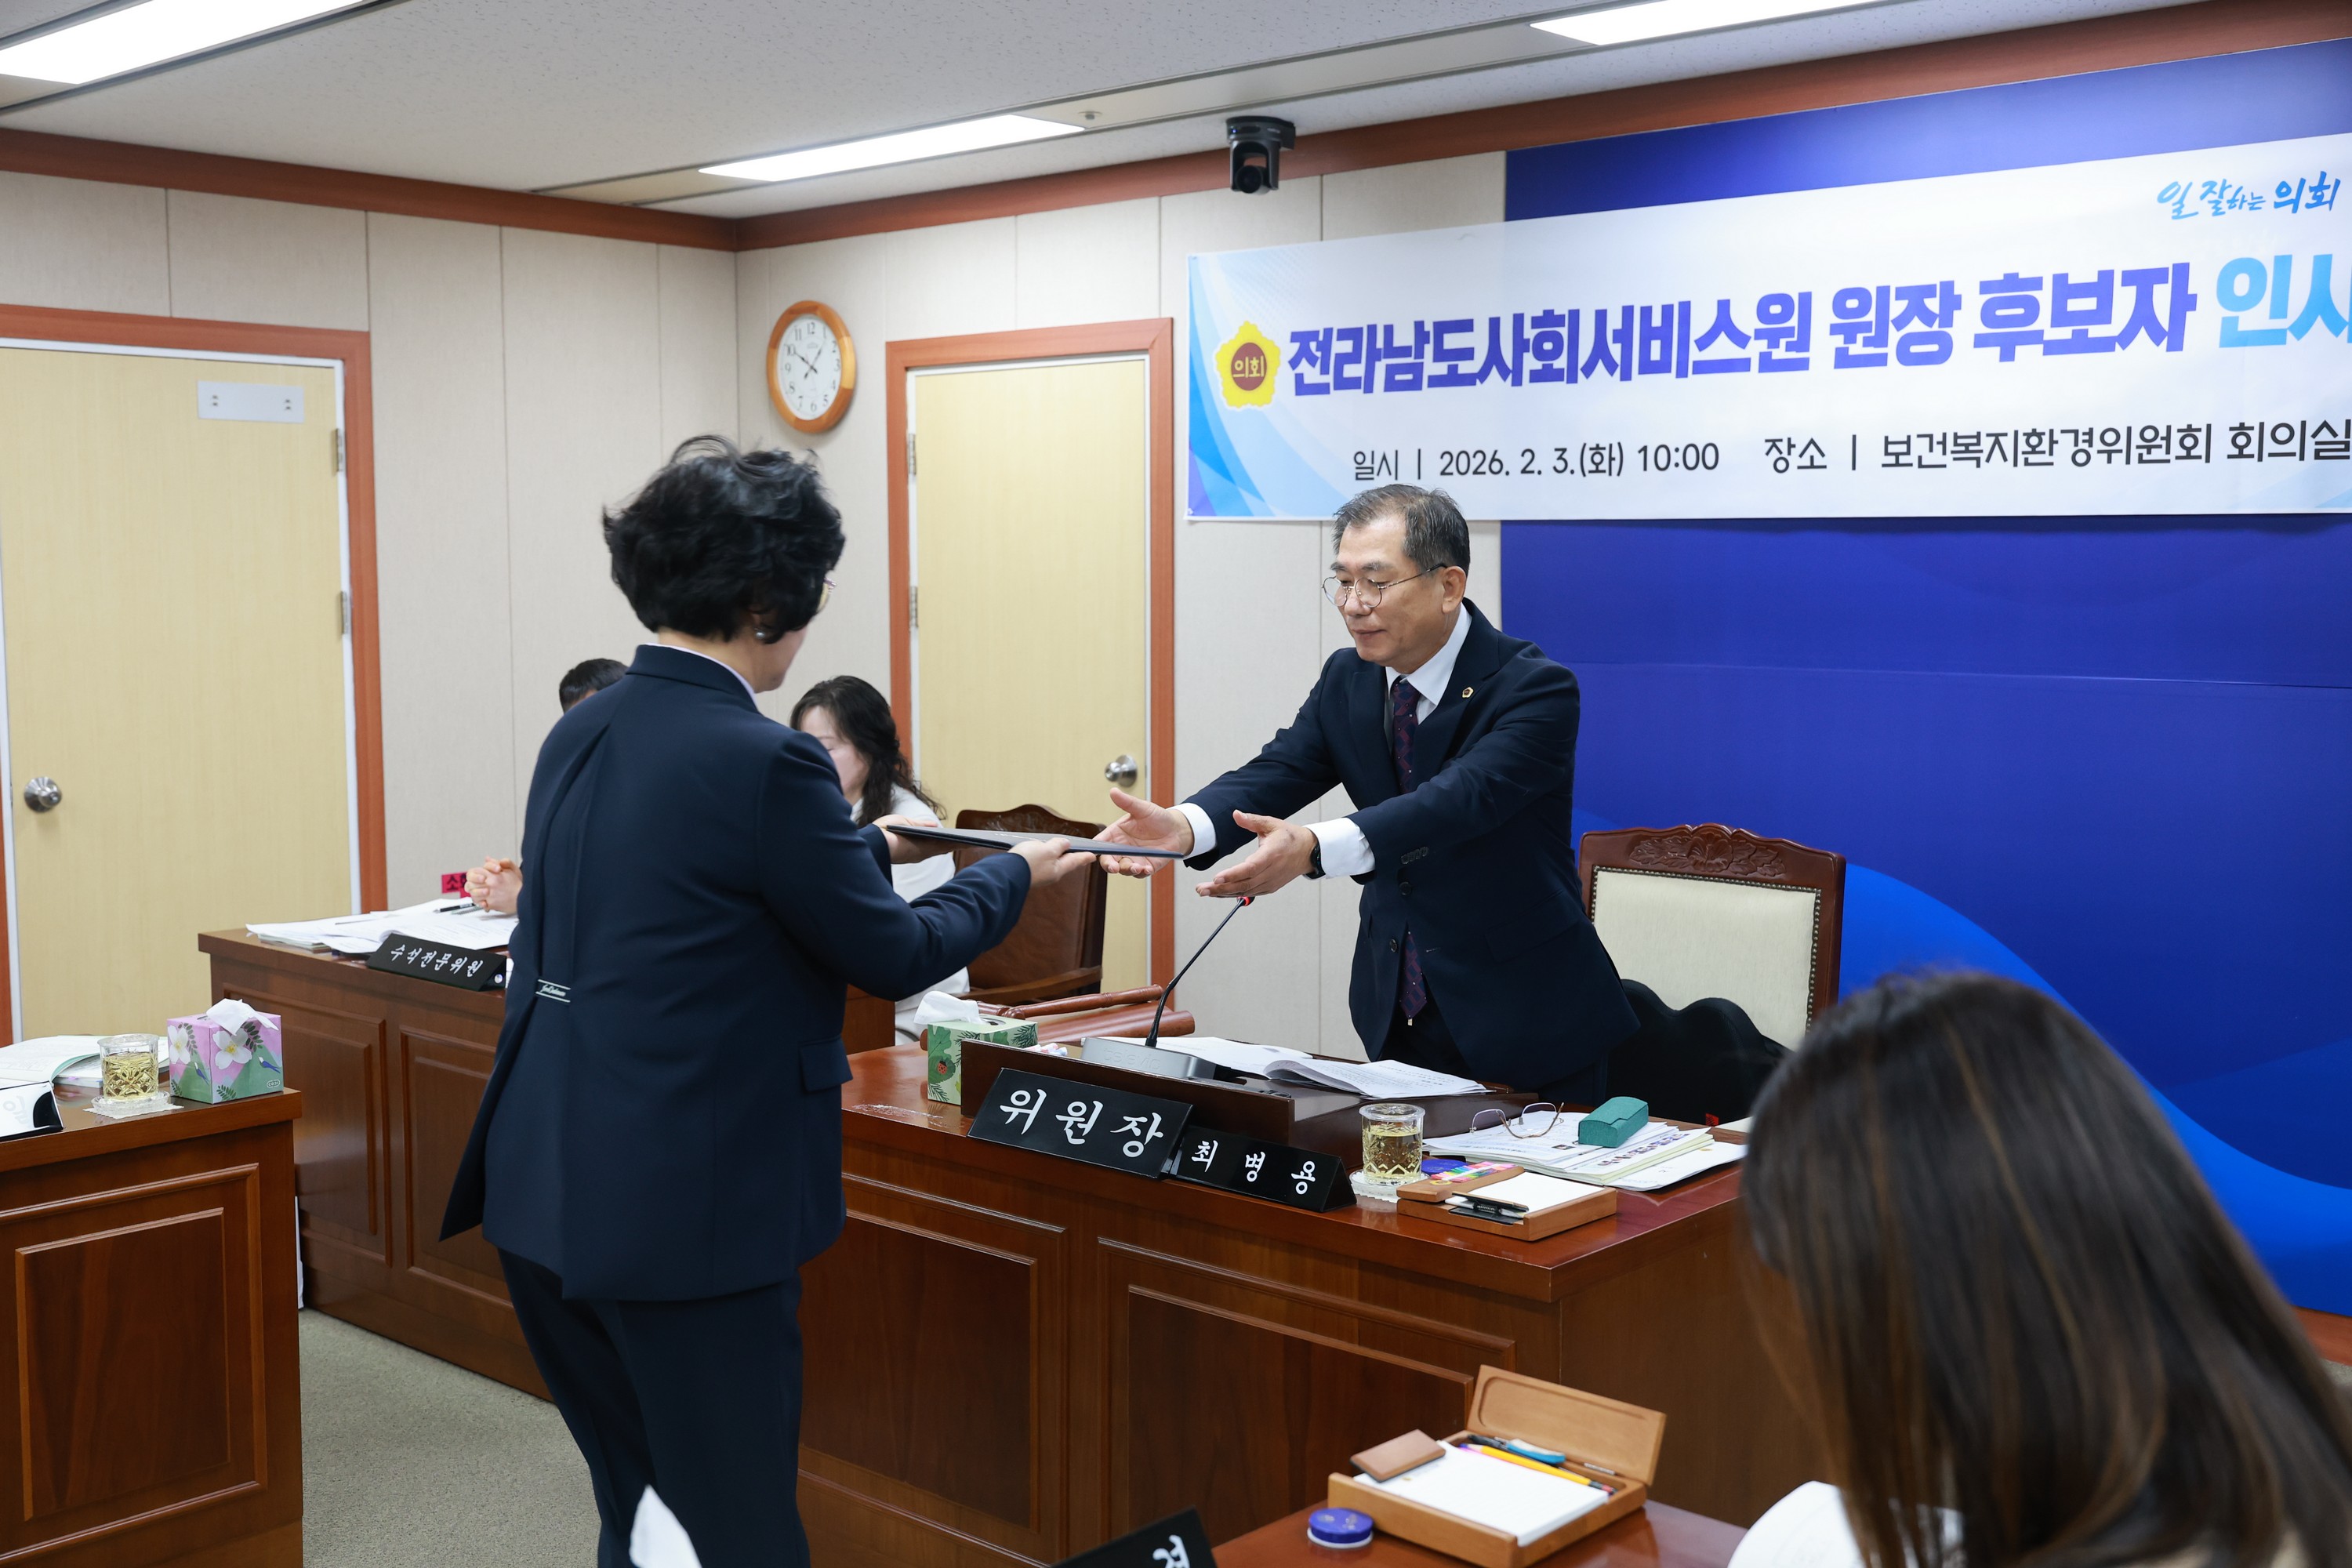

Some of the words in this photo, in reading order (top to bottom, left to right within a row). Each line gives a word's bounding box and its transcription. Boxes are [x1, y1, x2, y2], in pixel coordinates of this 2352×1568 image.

[2157, 181, 2199, 220] 일
[2199, 178, 2267, 217] 잘하는
[2273, 170, 2342, 214] 의회
[1288, 292, 1813, 397] 전라남도사회서비스원
[1829, 280, 1962, 369] 원장
[1973, 262, 2198, 363] 후보자
[1232, 355, 1265, 378] 의회
[1353, 450, 1399, 481] 일시
[1439, 449, 1510, 477] 2026.
[1637, 442, 1719, 472] 10:00
[1764, 437, 1828, 474] 장소
[1881, 423, 2212, 469] 보건복지환경위원회
[2227, 419, 2352, 463] 회의실
[390, 944, 484, 978] 수석전문위원
[1000, 1088, 1164, 1158] 위원장
